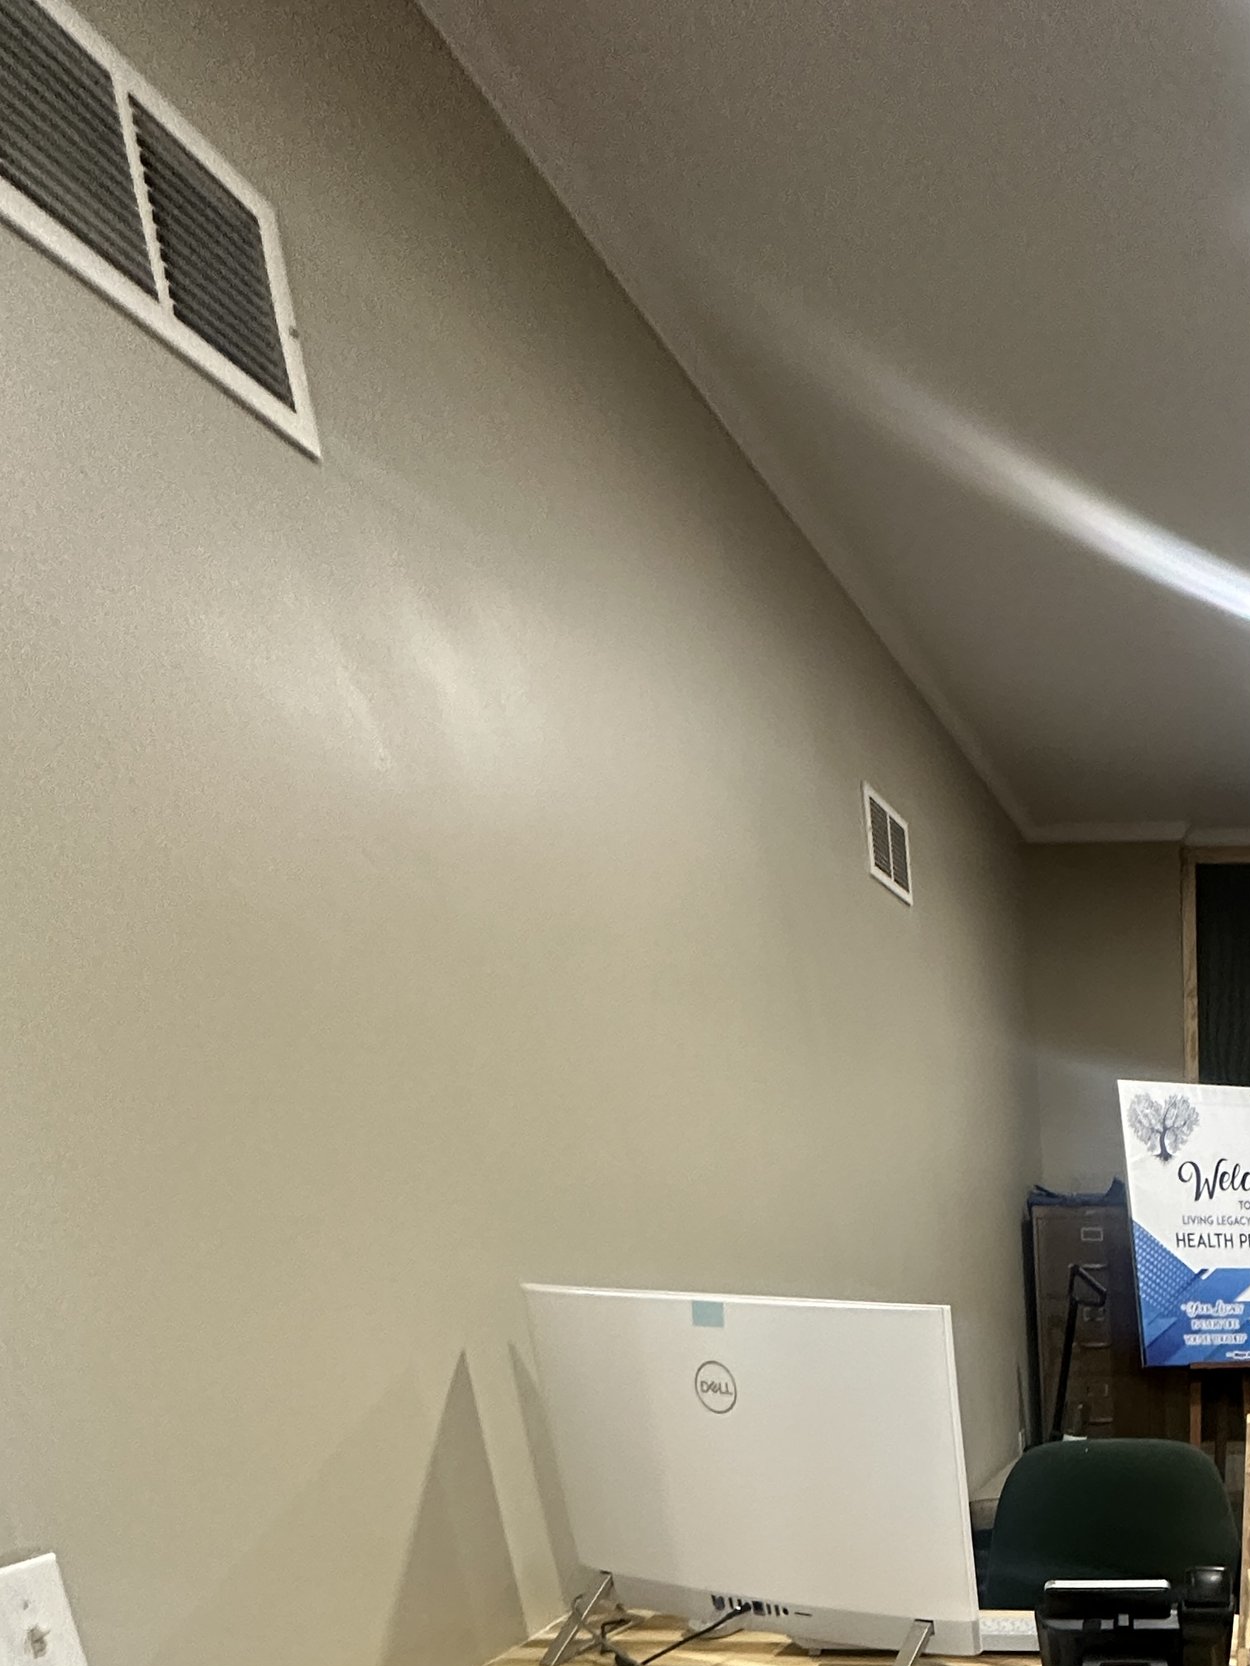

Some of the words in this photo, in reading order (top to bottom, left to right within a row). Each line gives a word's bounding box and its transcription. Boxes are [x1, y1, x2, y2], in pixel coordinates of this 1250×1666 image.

[1182, 1215, 1214, 1225] LIVING
[1175, 1232, 1234, 1248] HEALTH
[700, 1380, 733, 1395] DELL
